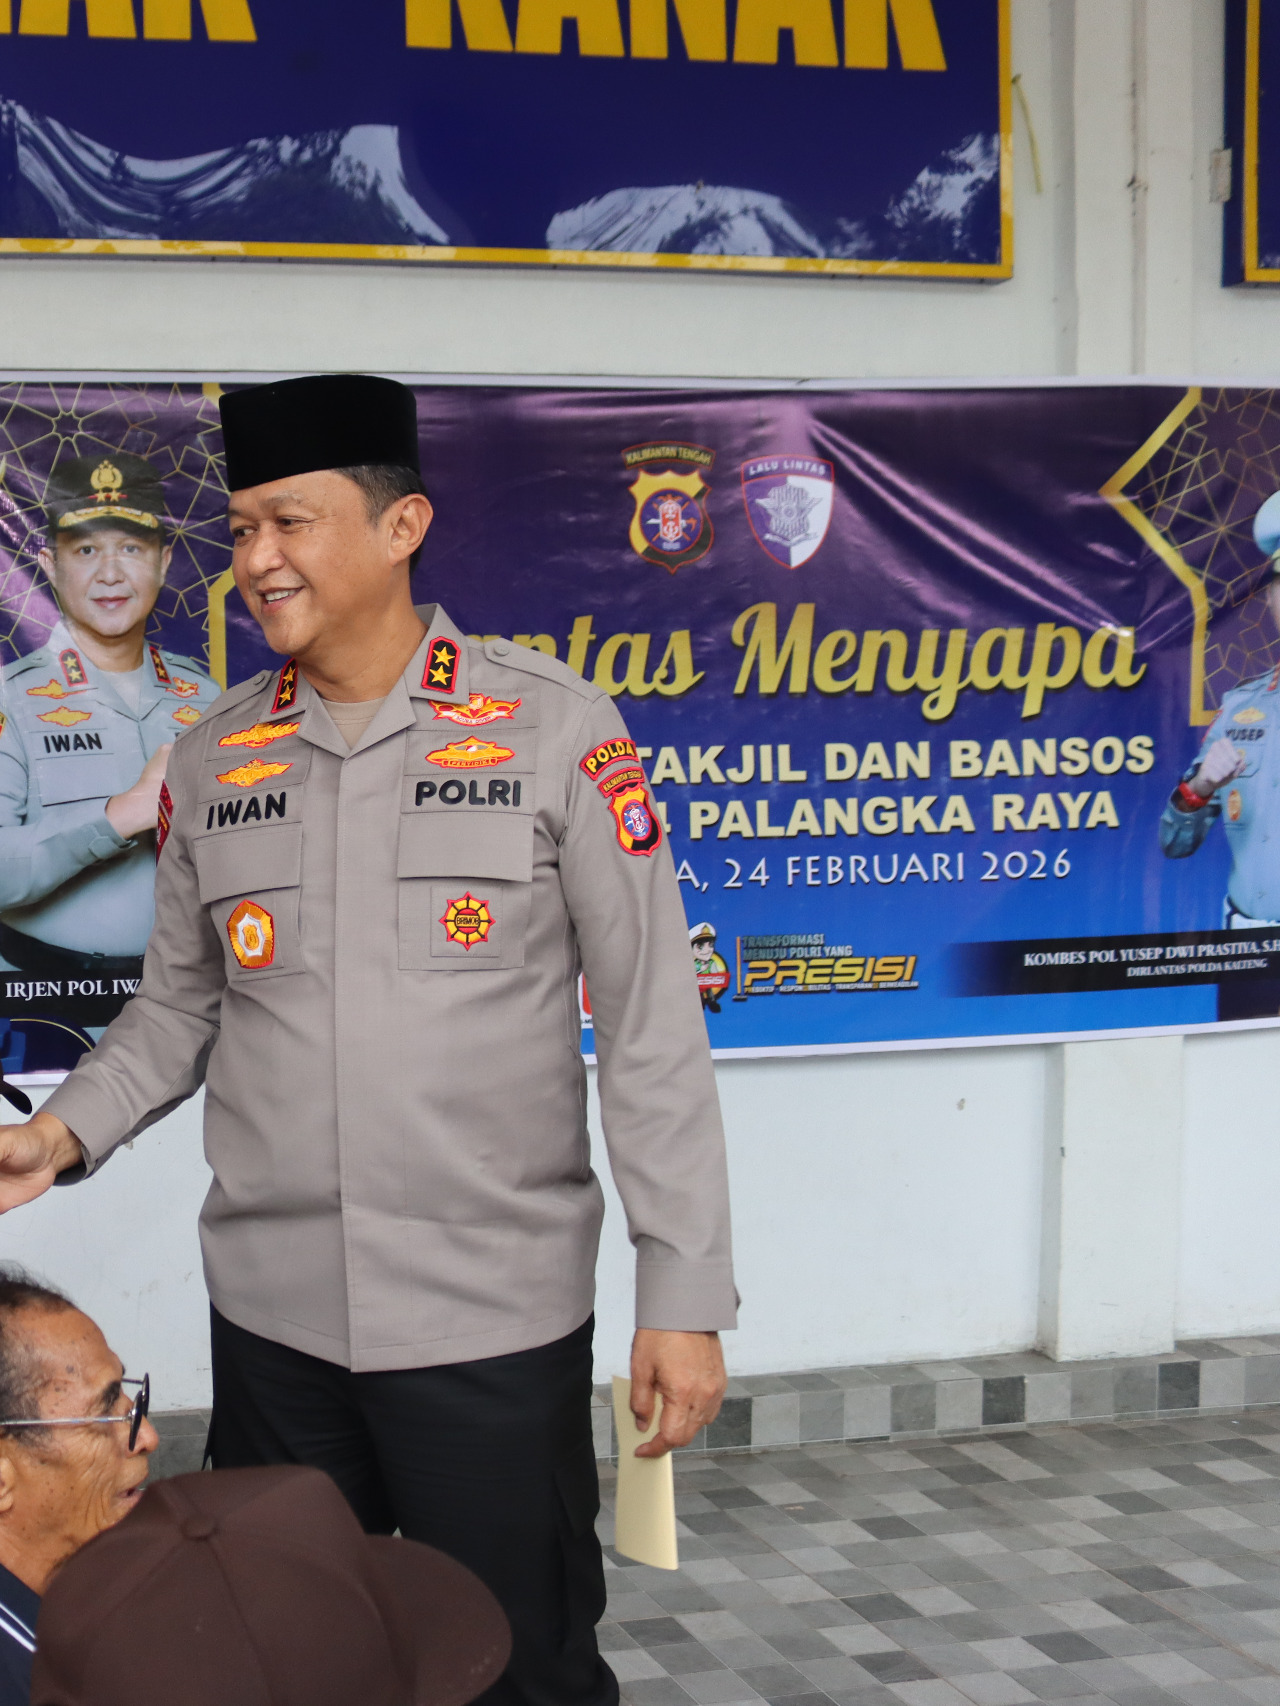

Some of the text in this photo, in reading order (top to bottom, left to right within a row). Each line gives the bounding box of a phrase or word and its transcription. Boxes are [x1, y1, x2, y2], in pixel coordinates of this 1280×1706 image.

[749, 460, 826, 475] LALU LINTAS
[731, 601, 1148, 721] Menyapa
[43, 732, 103, 754] IWAN
[1225, 728, 1265, 741] YUSEP
[585, 741, 636, 773] POLDA
[824, 741, 931, 781] DAN
[949, 735, 1155, 778] BANSOS
[415, 779, 521, 807] POLRI
[207, 792, 286, 830] IWAN
[689, 795, 976, 840] PALANGKA
[992, 791, 1120, 832] RAYA
[723, 857, 770, 888] 24
[786, 852, 965, 886] FEBRUARI
[980, 849, 1071, 881] 2026
[743, 933, 825, 948] TRANSFORMASI
[790, 946, 821, 959] POLRI
[823, 945, 853, 957] YANG
[1023, 951, 1086, 966] KOMBES
[1088, 949, 1119, 963] POL
[1119, 946, 1164, 962] YUSEP
[1165, 944, 1196, 959] DWI
[744, 956, 917, 987] PRESISI
[1127, 965, 1186, 977] DIRLANTAS
[1187, 962, 1222, 974] POLDA
[5, 981, 62, 1001] IRJEN
[67, 979, 108, 996] POL
